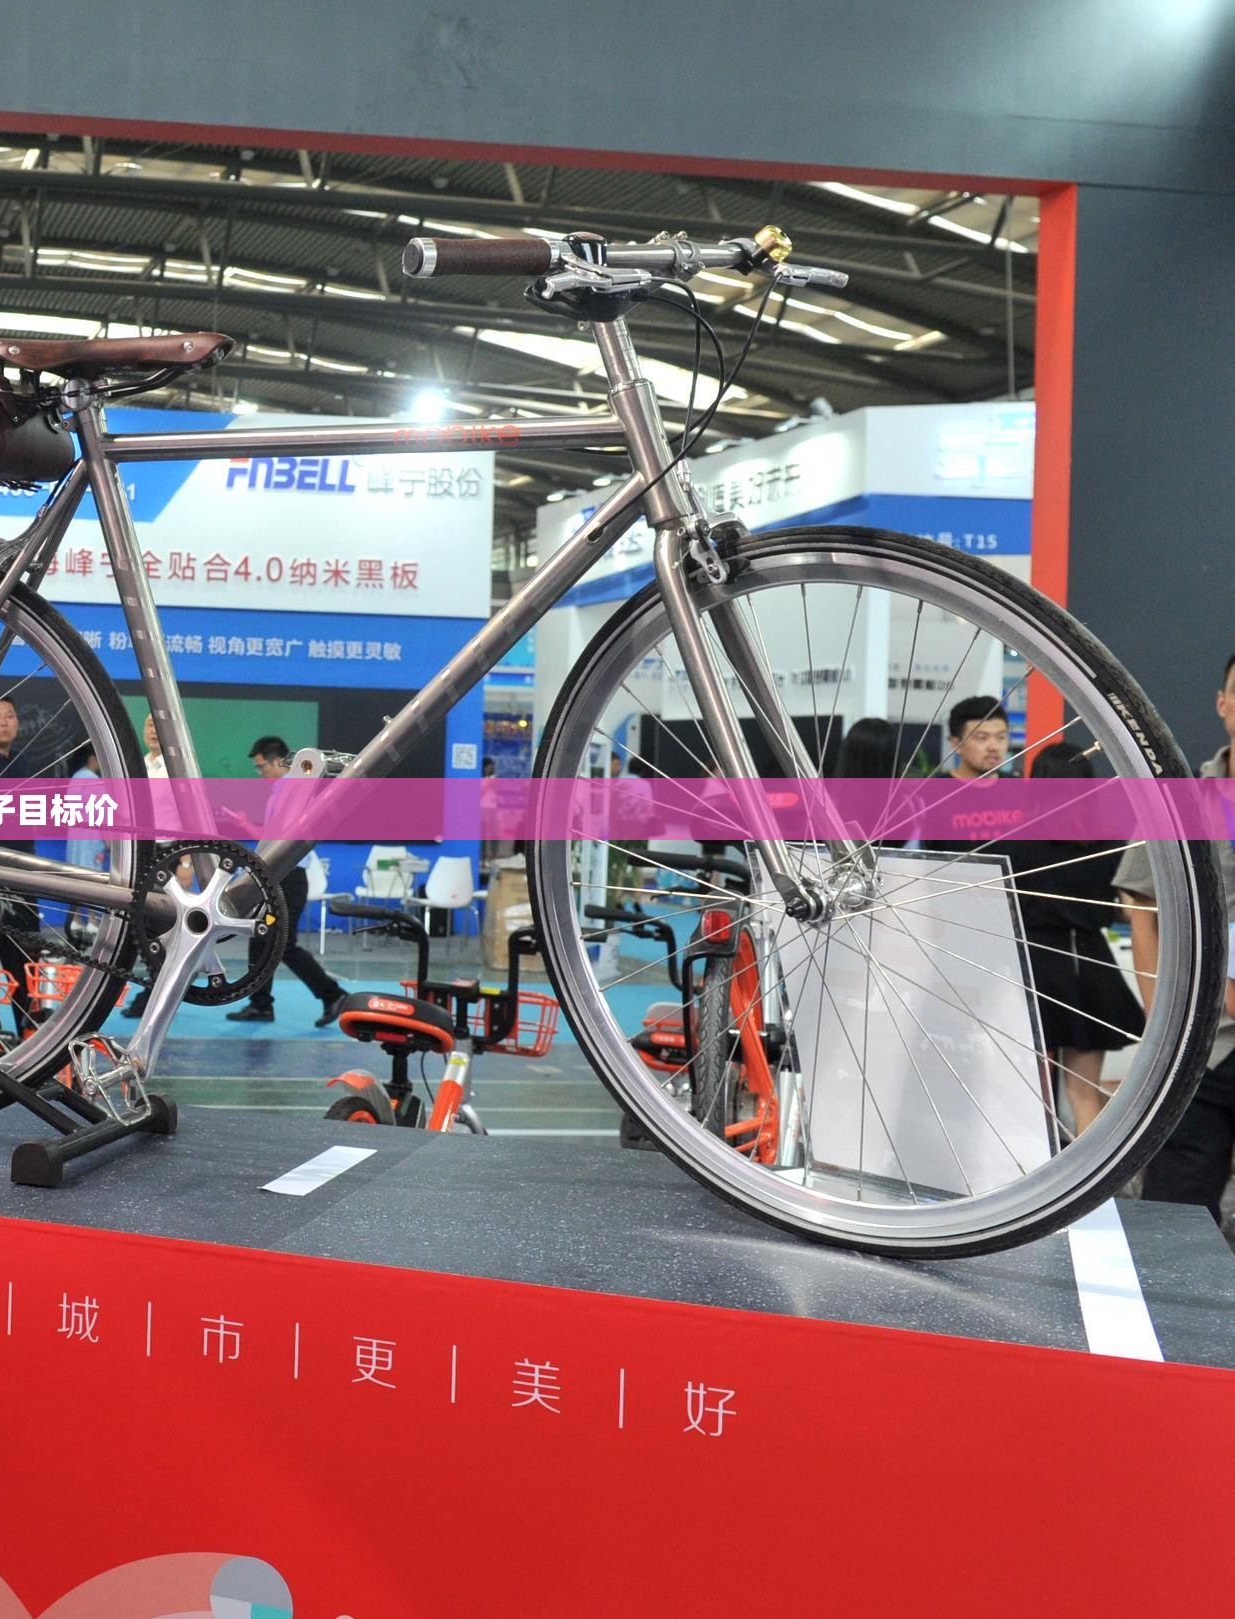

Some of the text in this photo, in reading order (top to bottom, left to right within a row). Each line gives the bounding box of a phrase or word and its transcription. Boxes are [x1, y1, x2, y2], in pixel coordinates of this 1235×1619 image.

[208, 636, 303, 657] 视角更宽广
[308, 639, 402, 661] 触摸更灵敏
[1115, 702, 1164, 776] KENDA
